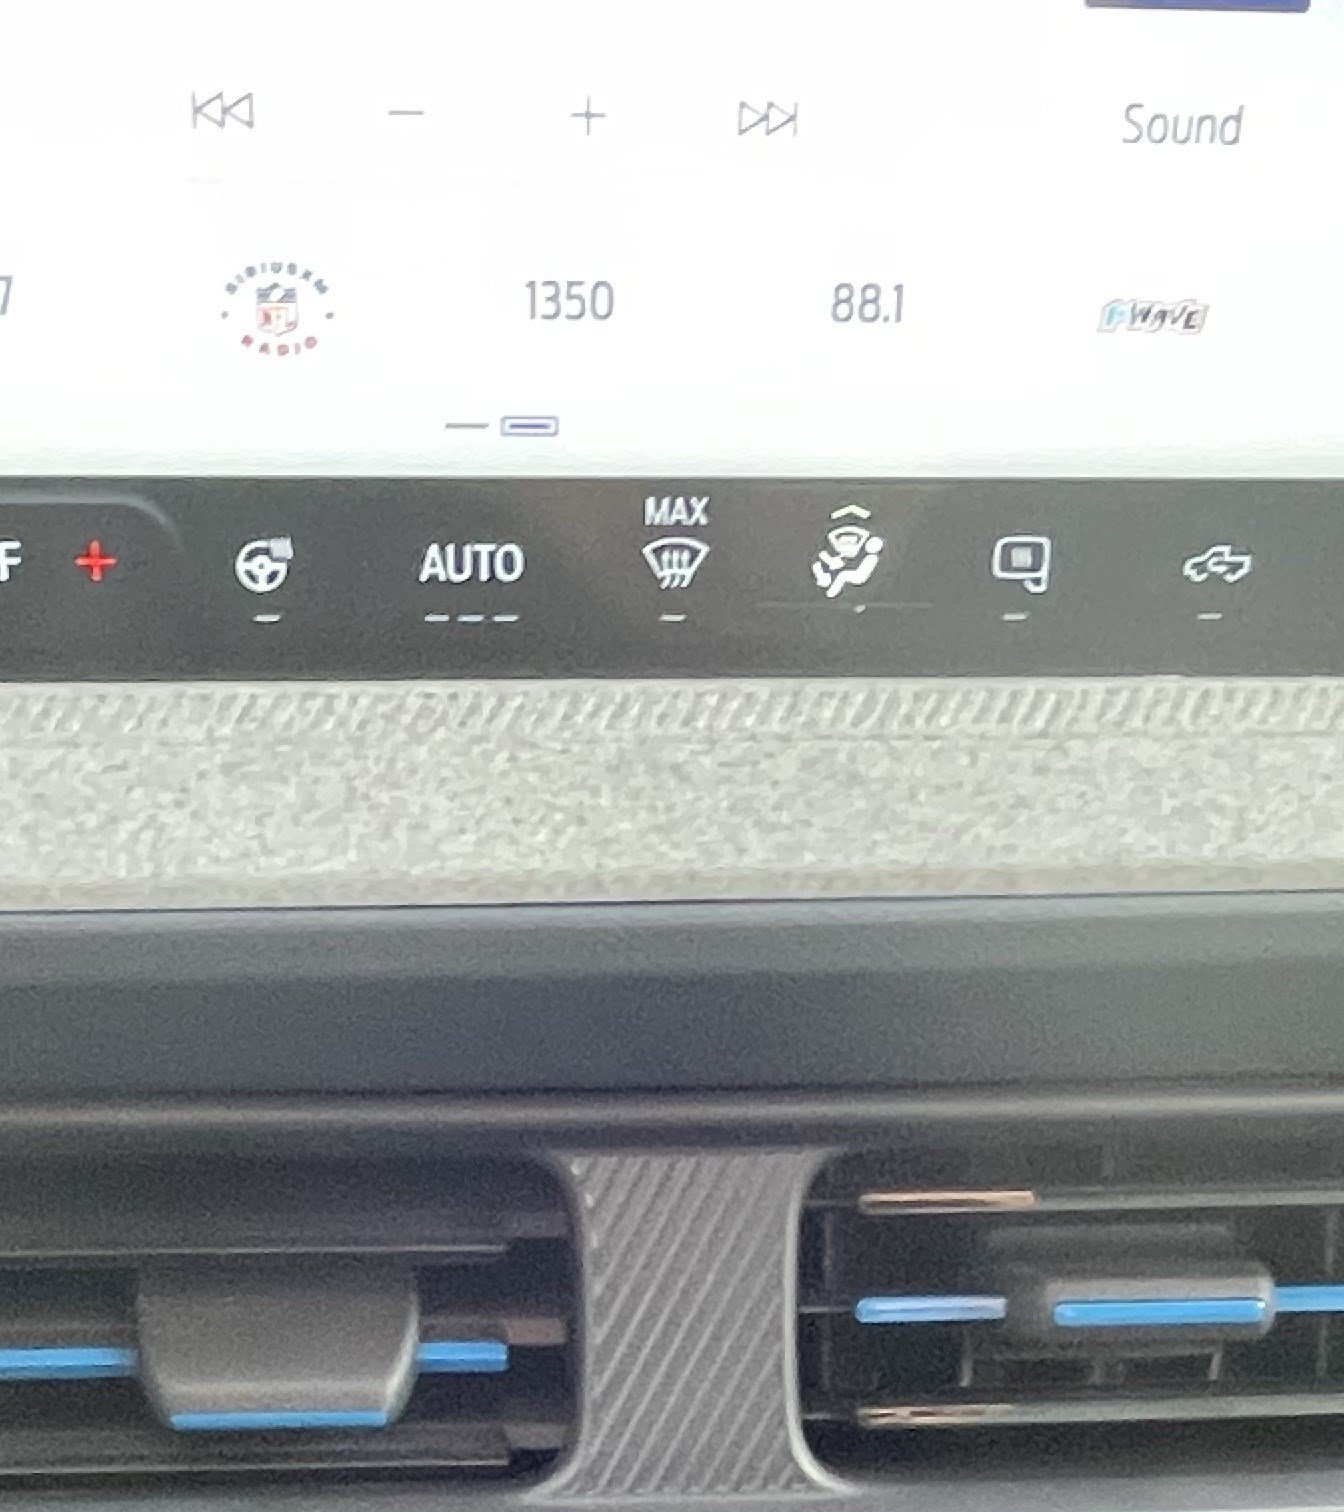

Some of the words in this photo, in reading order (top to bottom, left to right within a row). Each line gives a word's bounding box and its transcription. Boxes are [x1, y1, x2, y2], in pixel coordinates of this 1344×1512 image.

[1122, 102, 1244, 147] Sound
[524, 280, 615, 321] 1350
[830, 282, 905, 324] 88.1
[644, 496, 710, 526] MAX
[418, 542, 526, 584] AUTO
